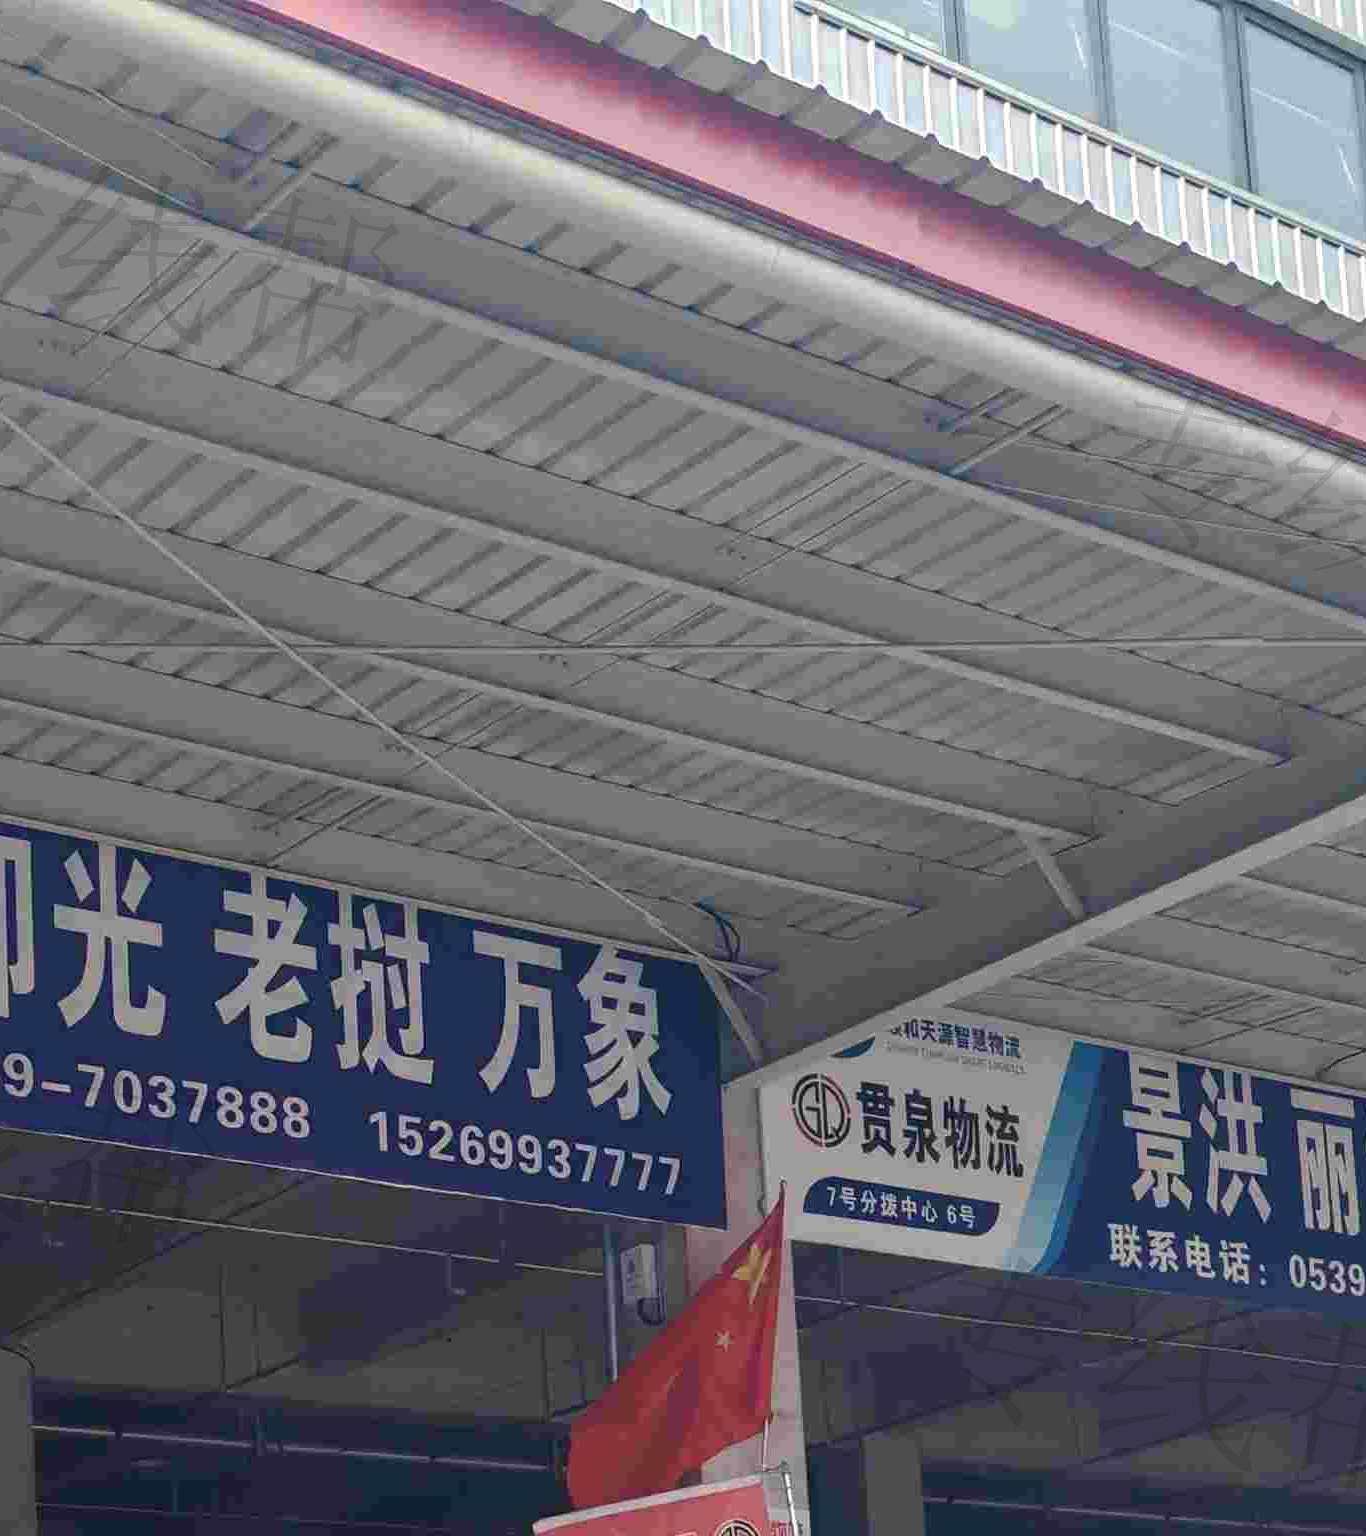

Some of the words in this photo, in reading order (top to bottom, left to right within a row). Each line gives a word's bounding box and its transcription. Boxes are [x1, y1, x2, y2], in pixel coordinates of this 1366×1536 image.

[213, 869, 435, 1085] 老挝
[471, 929, 672, 1121] 万象
[367, 1110, 683, 1196] 15269937777
[855, 1080, 1025, 1178] 贯泉物流
[1122, 1054, 1273, 1224] 景洪
[826, 1185, 939, 1224] 7号分拨中心
[946, 1203, 977, 1229] 6号
